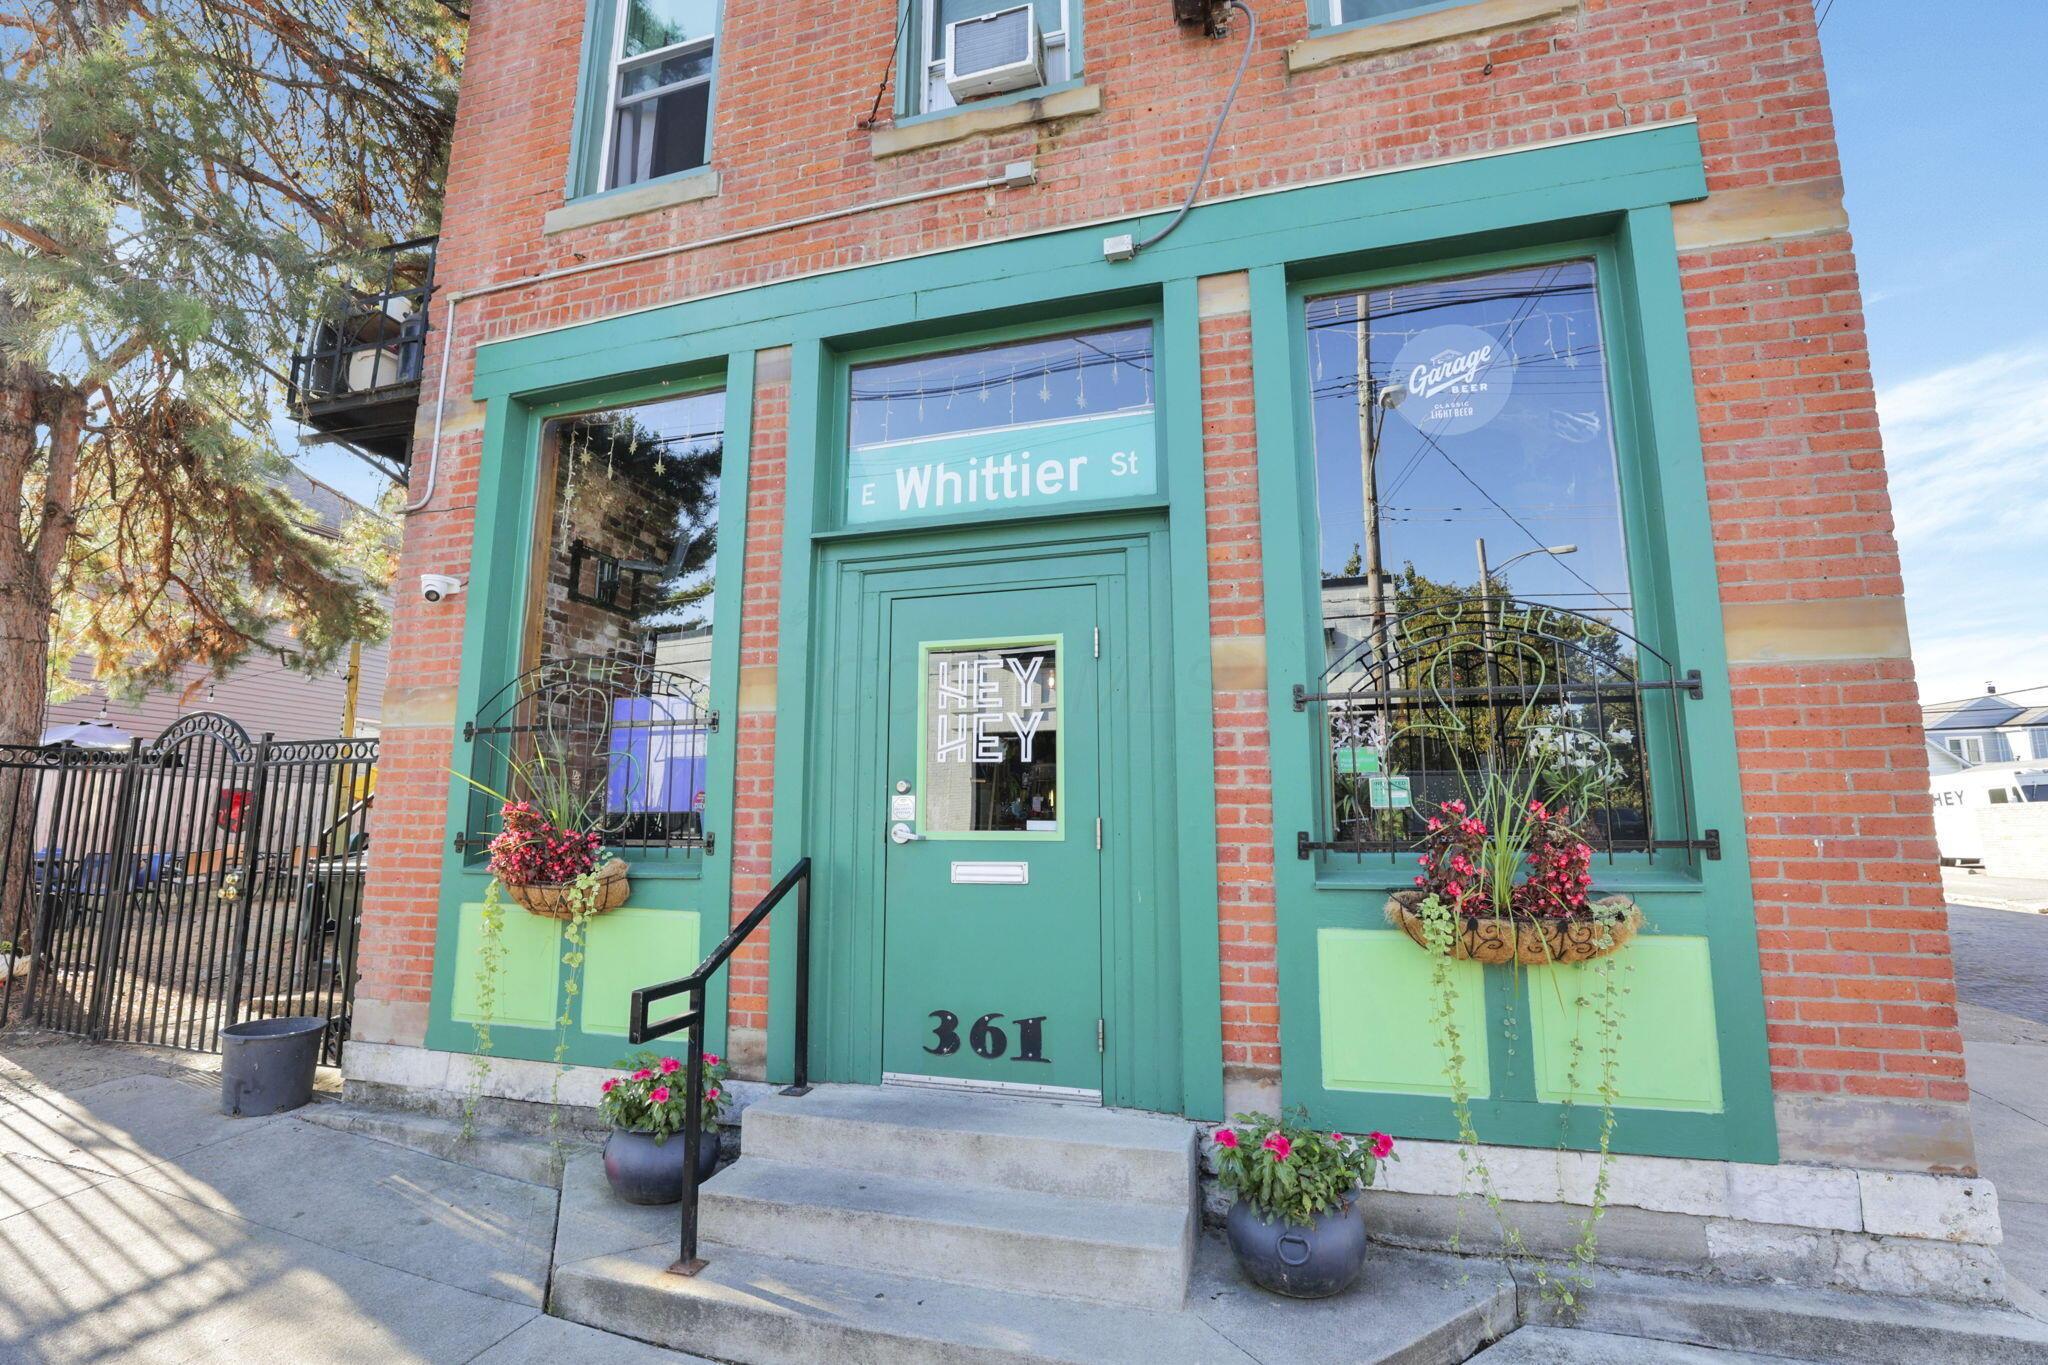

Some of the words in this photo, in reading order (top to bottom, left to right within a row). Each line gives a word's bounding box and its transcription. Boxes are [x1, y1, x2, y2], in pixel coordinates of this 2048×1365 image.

[1408, 345, 1491, 398] Garage
[1451, 383, 1488, 394] BEER
[1431, 409, 1453, 419] LIGHT
[1454, 407, 1474, 417] BEER
[1434, 401, 1470, 410] CLASSIC
[861, 483, 876, 506] E
[896, 451, 1088, 511] Whittier
[1111, 450, 1139, 476] St
[938, 656, 1044, 709] HEY
[937, 711, 1044, 763] HEY
[922, 1010, 1052, 1063] 361
